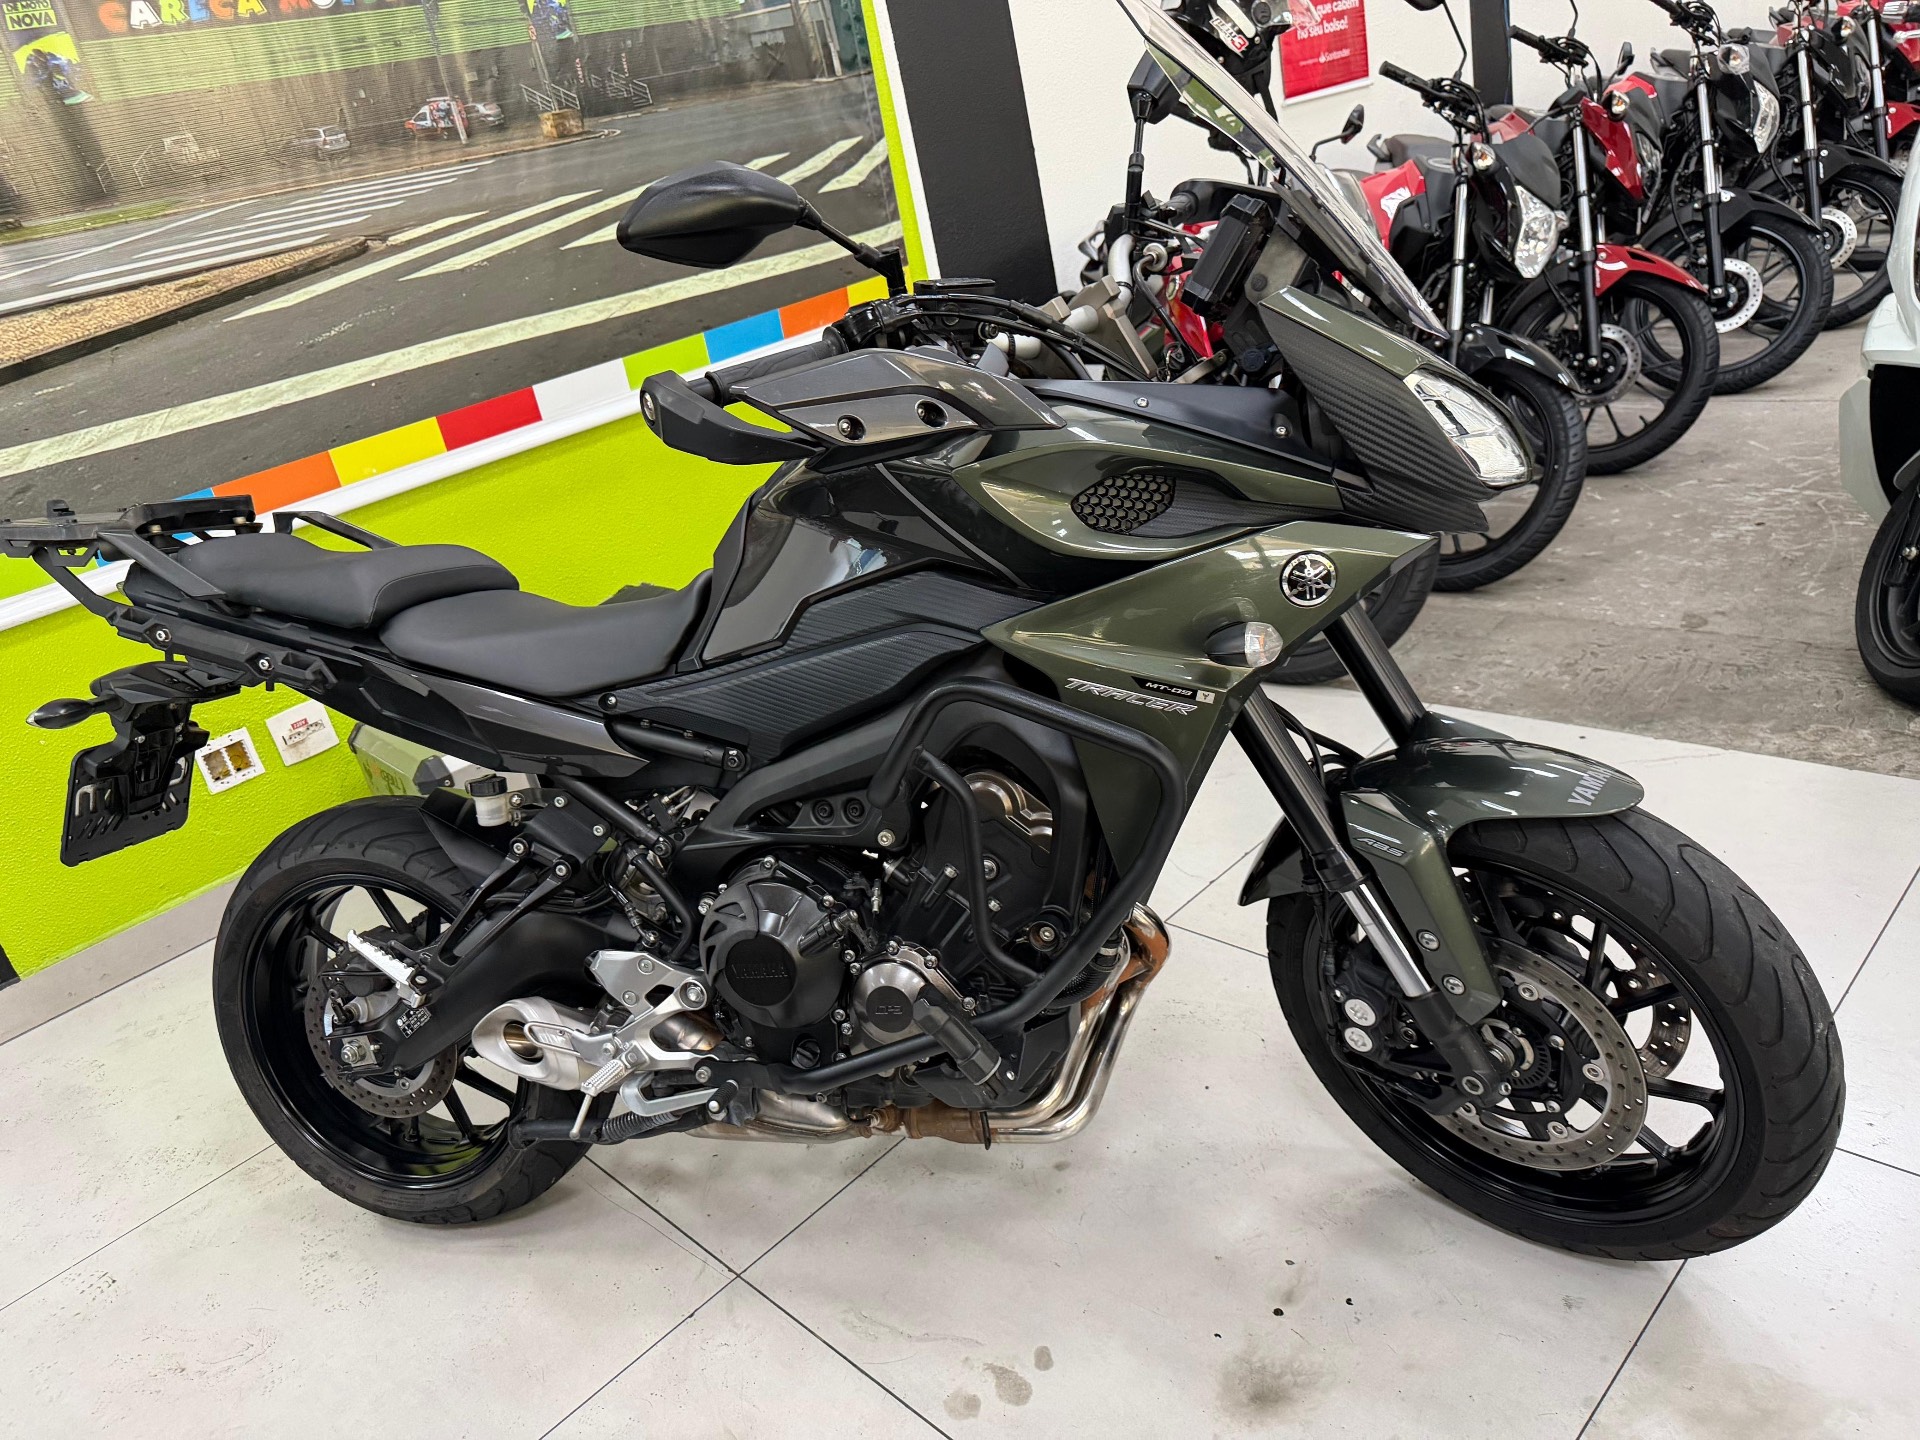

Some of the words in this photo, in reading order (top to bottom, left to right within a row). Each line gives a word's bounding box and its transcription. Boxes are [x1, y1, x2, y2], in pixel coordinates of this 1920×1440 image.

[6, 2, 19, 12] DE
[97, 0, 267, 33] CARECA
[9, 12, 55, 29] NOVA
[1065, 677, 1198, 715] TRACER
[1567, 764, 1615, 807] YAMAH
[1355, 838, 1405, 857] ABS
